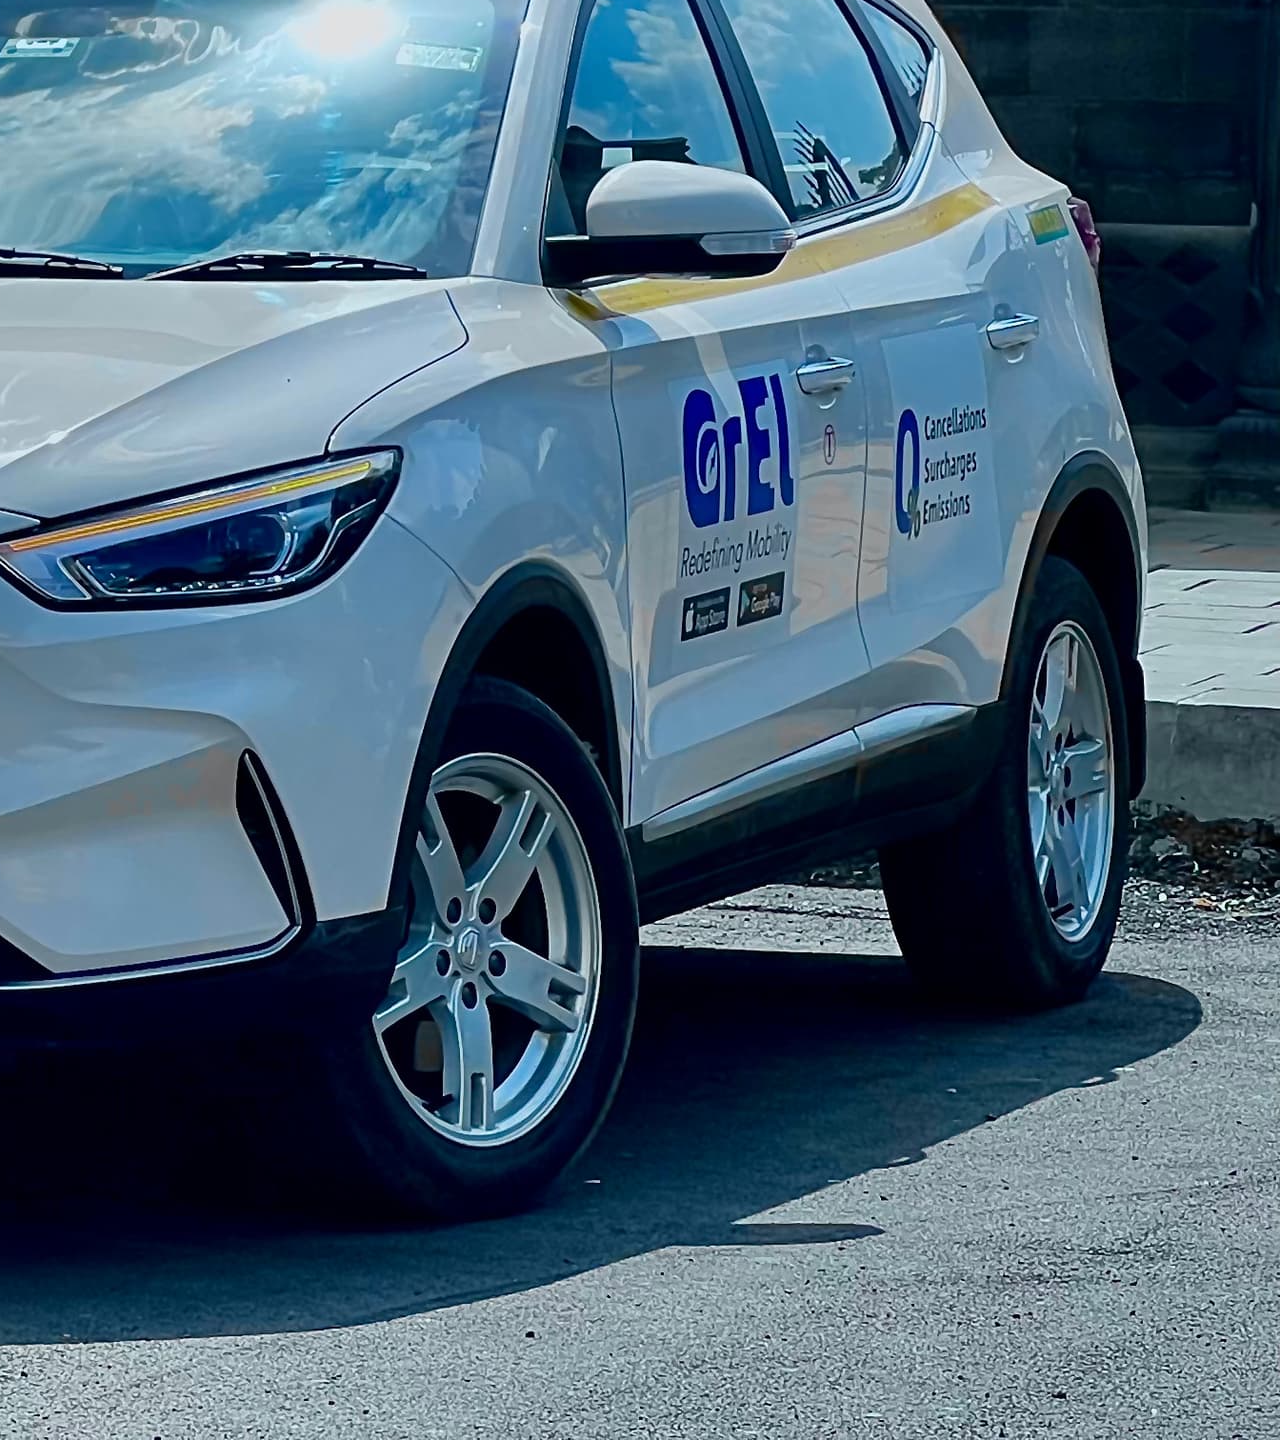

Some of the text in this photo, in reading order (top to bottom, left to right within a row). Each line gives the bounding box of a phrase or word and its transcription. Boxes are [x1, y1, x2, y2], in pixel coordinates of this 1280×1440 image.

[924, 405, 986, 440] Cancellations
[924, 451, 977, 483] Surcharges
[923, 491, 970, 525] Emissions
[681, 522, 792, 578] Redefining Mobility
